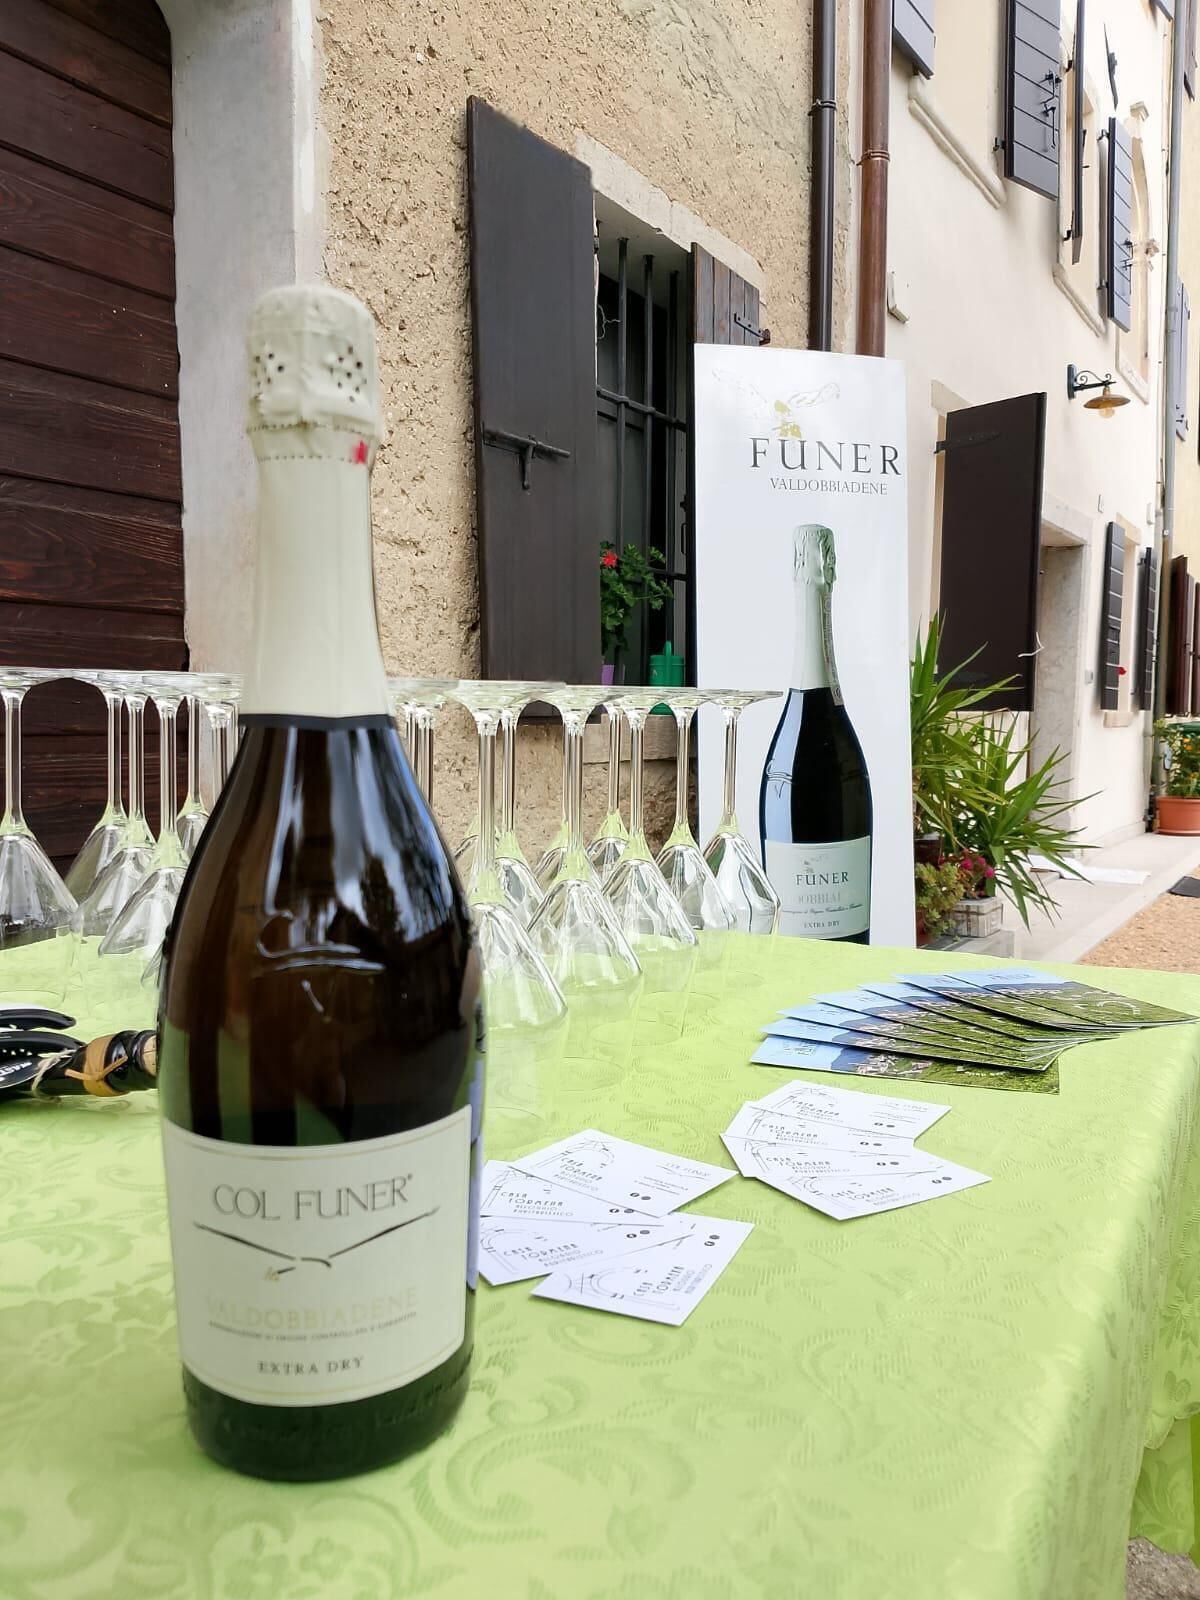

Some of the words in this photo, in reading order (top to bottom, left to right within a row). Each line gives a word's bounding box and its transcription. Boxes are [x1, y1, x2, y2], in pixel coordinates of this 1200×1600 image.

[750, 437, 902, 475] FUNER
[770, 478, 888, 495] VALDOBBIADENE
[796, 871, 849, 886] FUNER
[213, 1183, 281, 1221] COL
[294, 1175, 410, 1221] FUNER
[206, 1288, 418, 1330] VALDOBBIADENE
[257, 1359, 320, 1376] EXTRA
[327, 1355, 365, 1374] DRY
